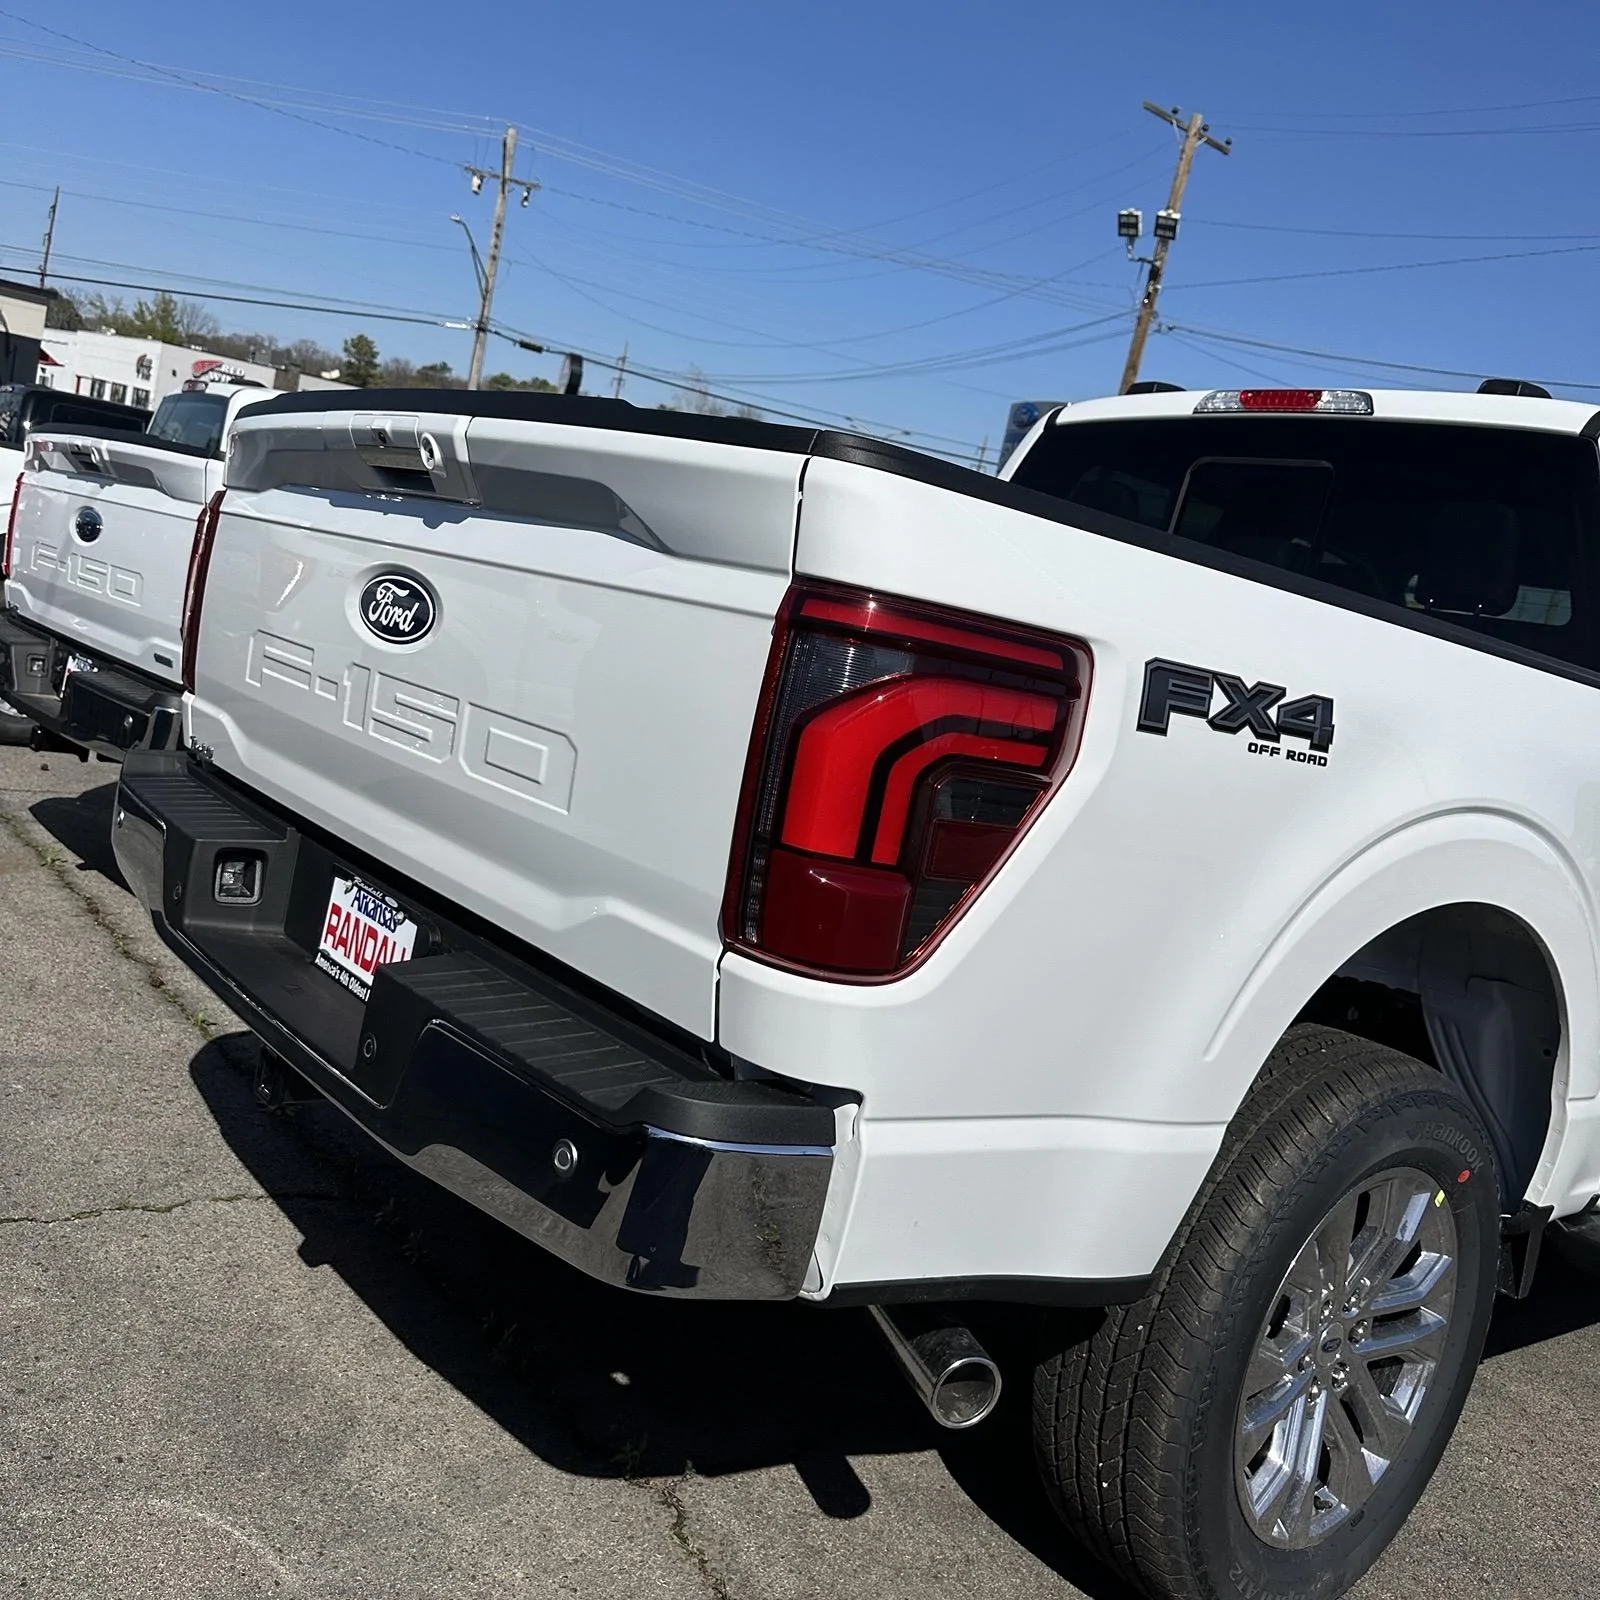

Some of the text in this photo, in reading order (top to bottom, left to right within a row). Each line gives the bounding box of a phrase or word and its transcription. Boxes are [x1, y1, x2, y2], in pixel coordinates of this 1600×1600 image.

[31, 541, 144, 607] F-150
[369, 582, 420, 632] Ford
[246, 629, 578, 815] F-150
[1136, 657, 1335, 753] FX4
[1247, 742, 1328, 767] OFF ROAD
[350, 888, 399, 933] Arkansas
[353, 876, 383, 900] Randall
[314, 952, 340, 980] America's
[348, 976, 367, 1000] Oldest
